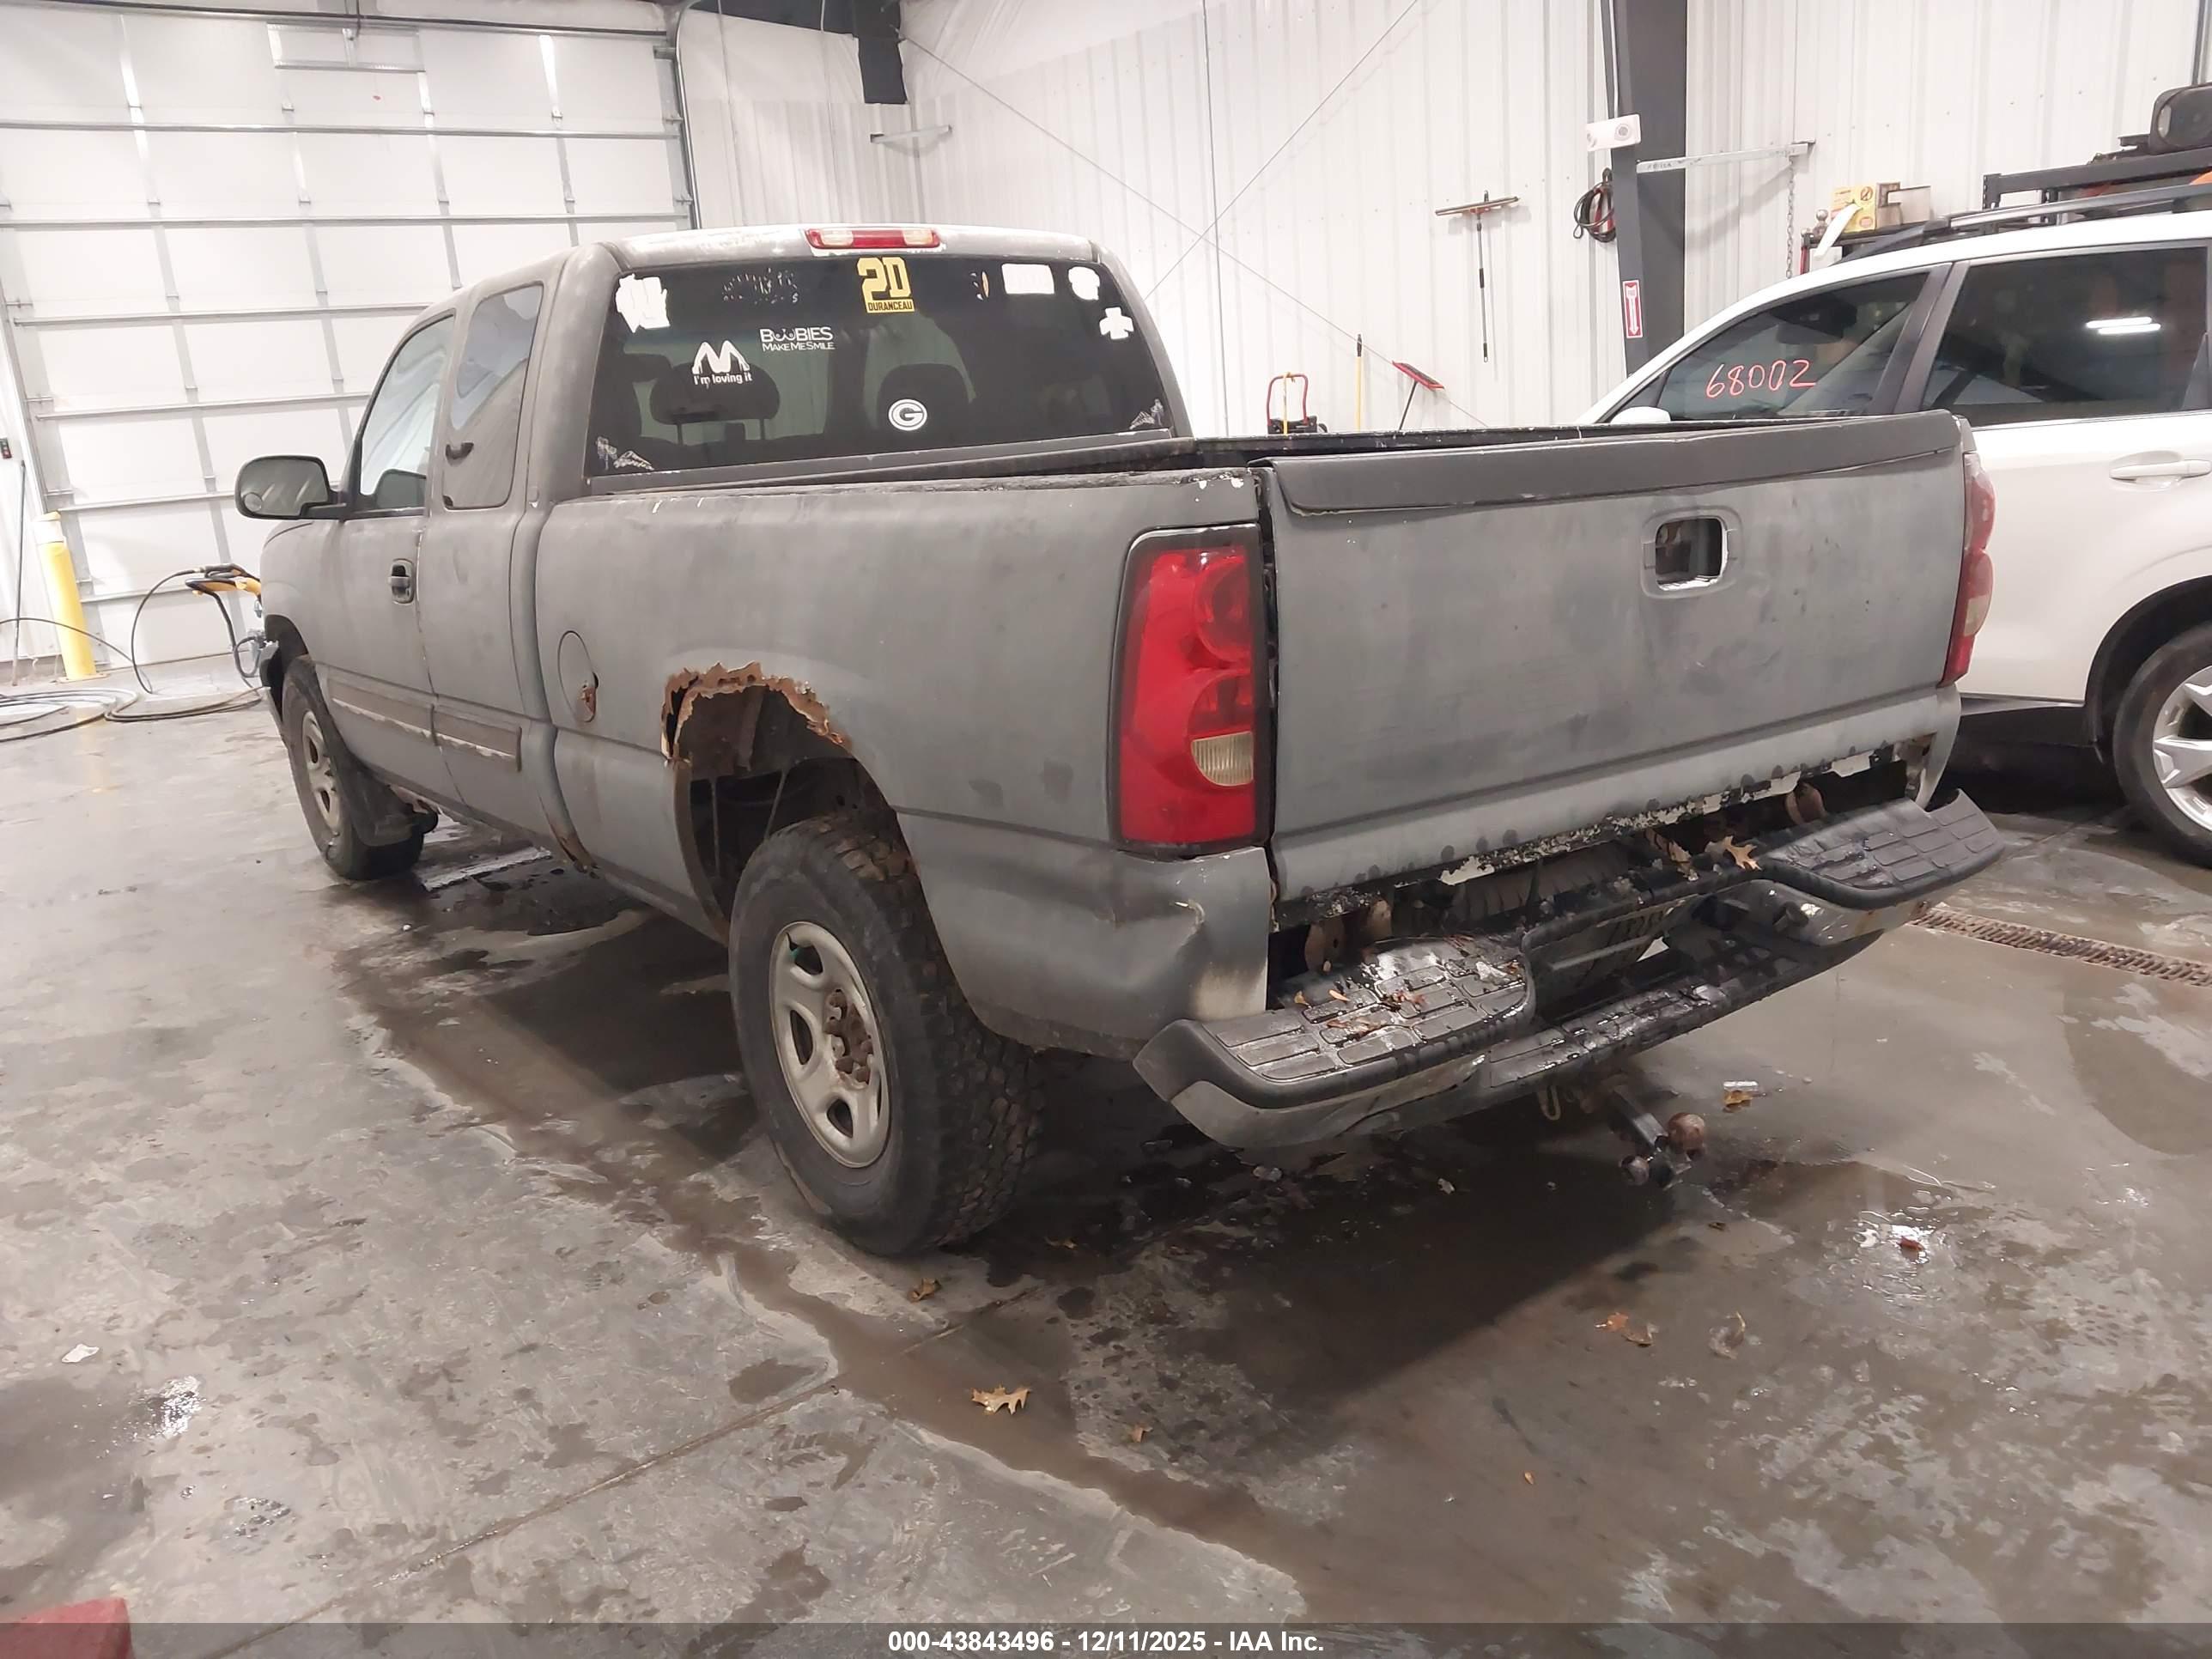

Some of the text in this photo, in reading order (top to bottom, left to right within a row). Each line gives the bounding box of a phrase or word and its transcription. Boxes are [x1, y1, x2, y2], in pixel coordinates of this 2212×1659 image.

[867, 301, 913, 311] DURANCEAU
[694, 371, 753, 386] I'm loving it
[1705, 358, 1817, 398] 68002
